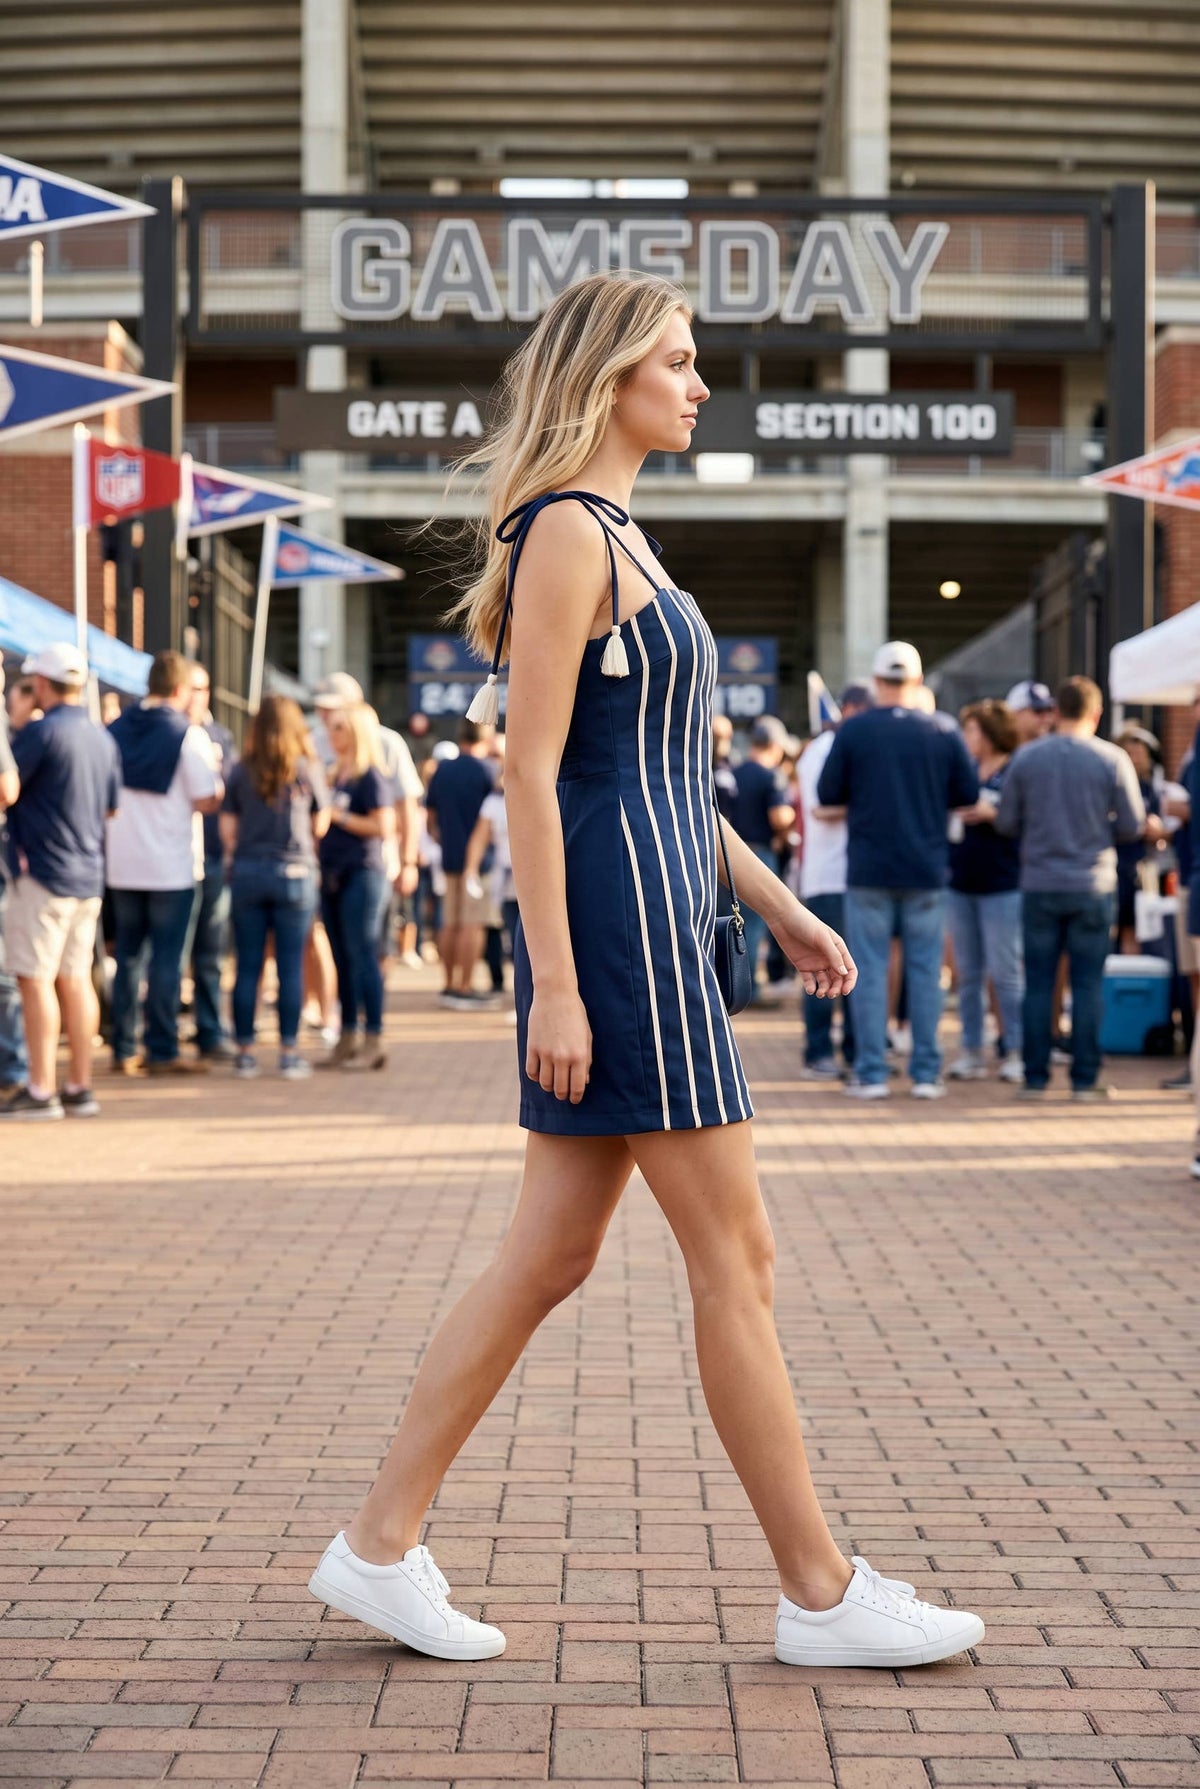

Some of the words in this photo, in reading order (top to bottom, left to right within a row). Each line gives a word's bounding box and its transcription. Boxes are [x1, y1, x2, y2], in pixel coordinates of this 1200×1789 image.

[0, 175, 48, 221] A
[331, 218, 950, 324] GAMEDAY
[347, 400, 447, 438] GATE
[451, 401, 484, 438] A
[755, 402, 920, 440] SECTION
[926, 403, 997, 441] 100
